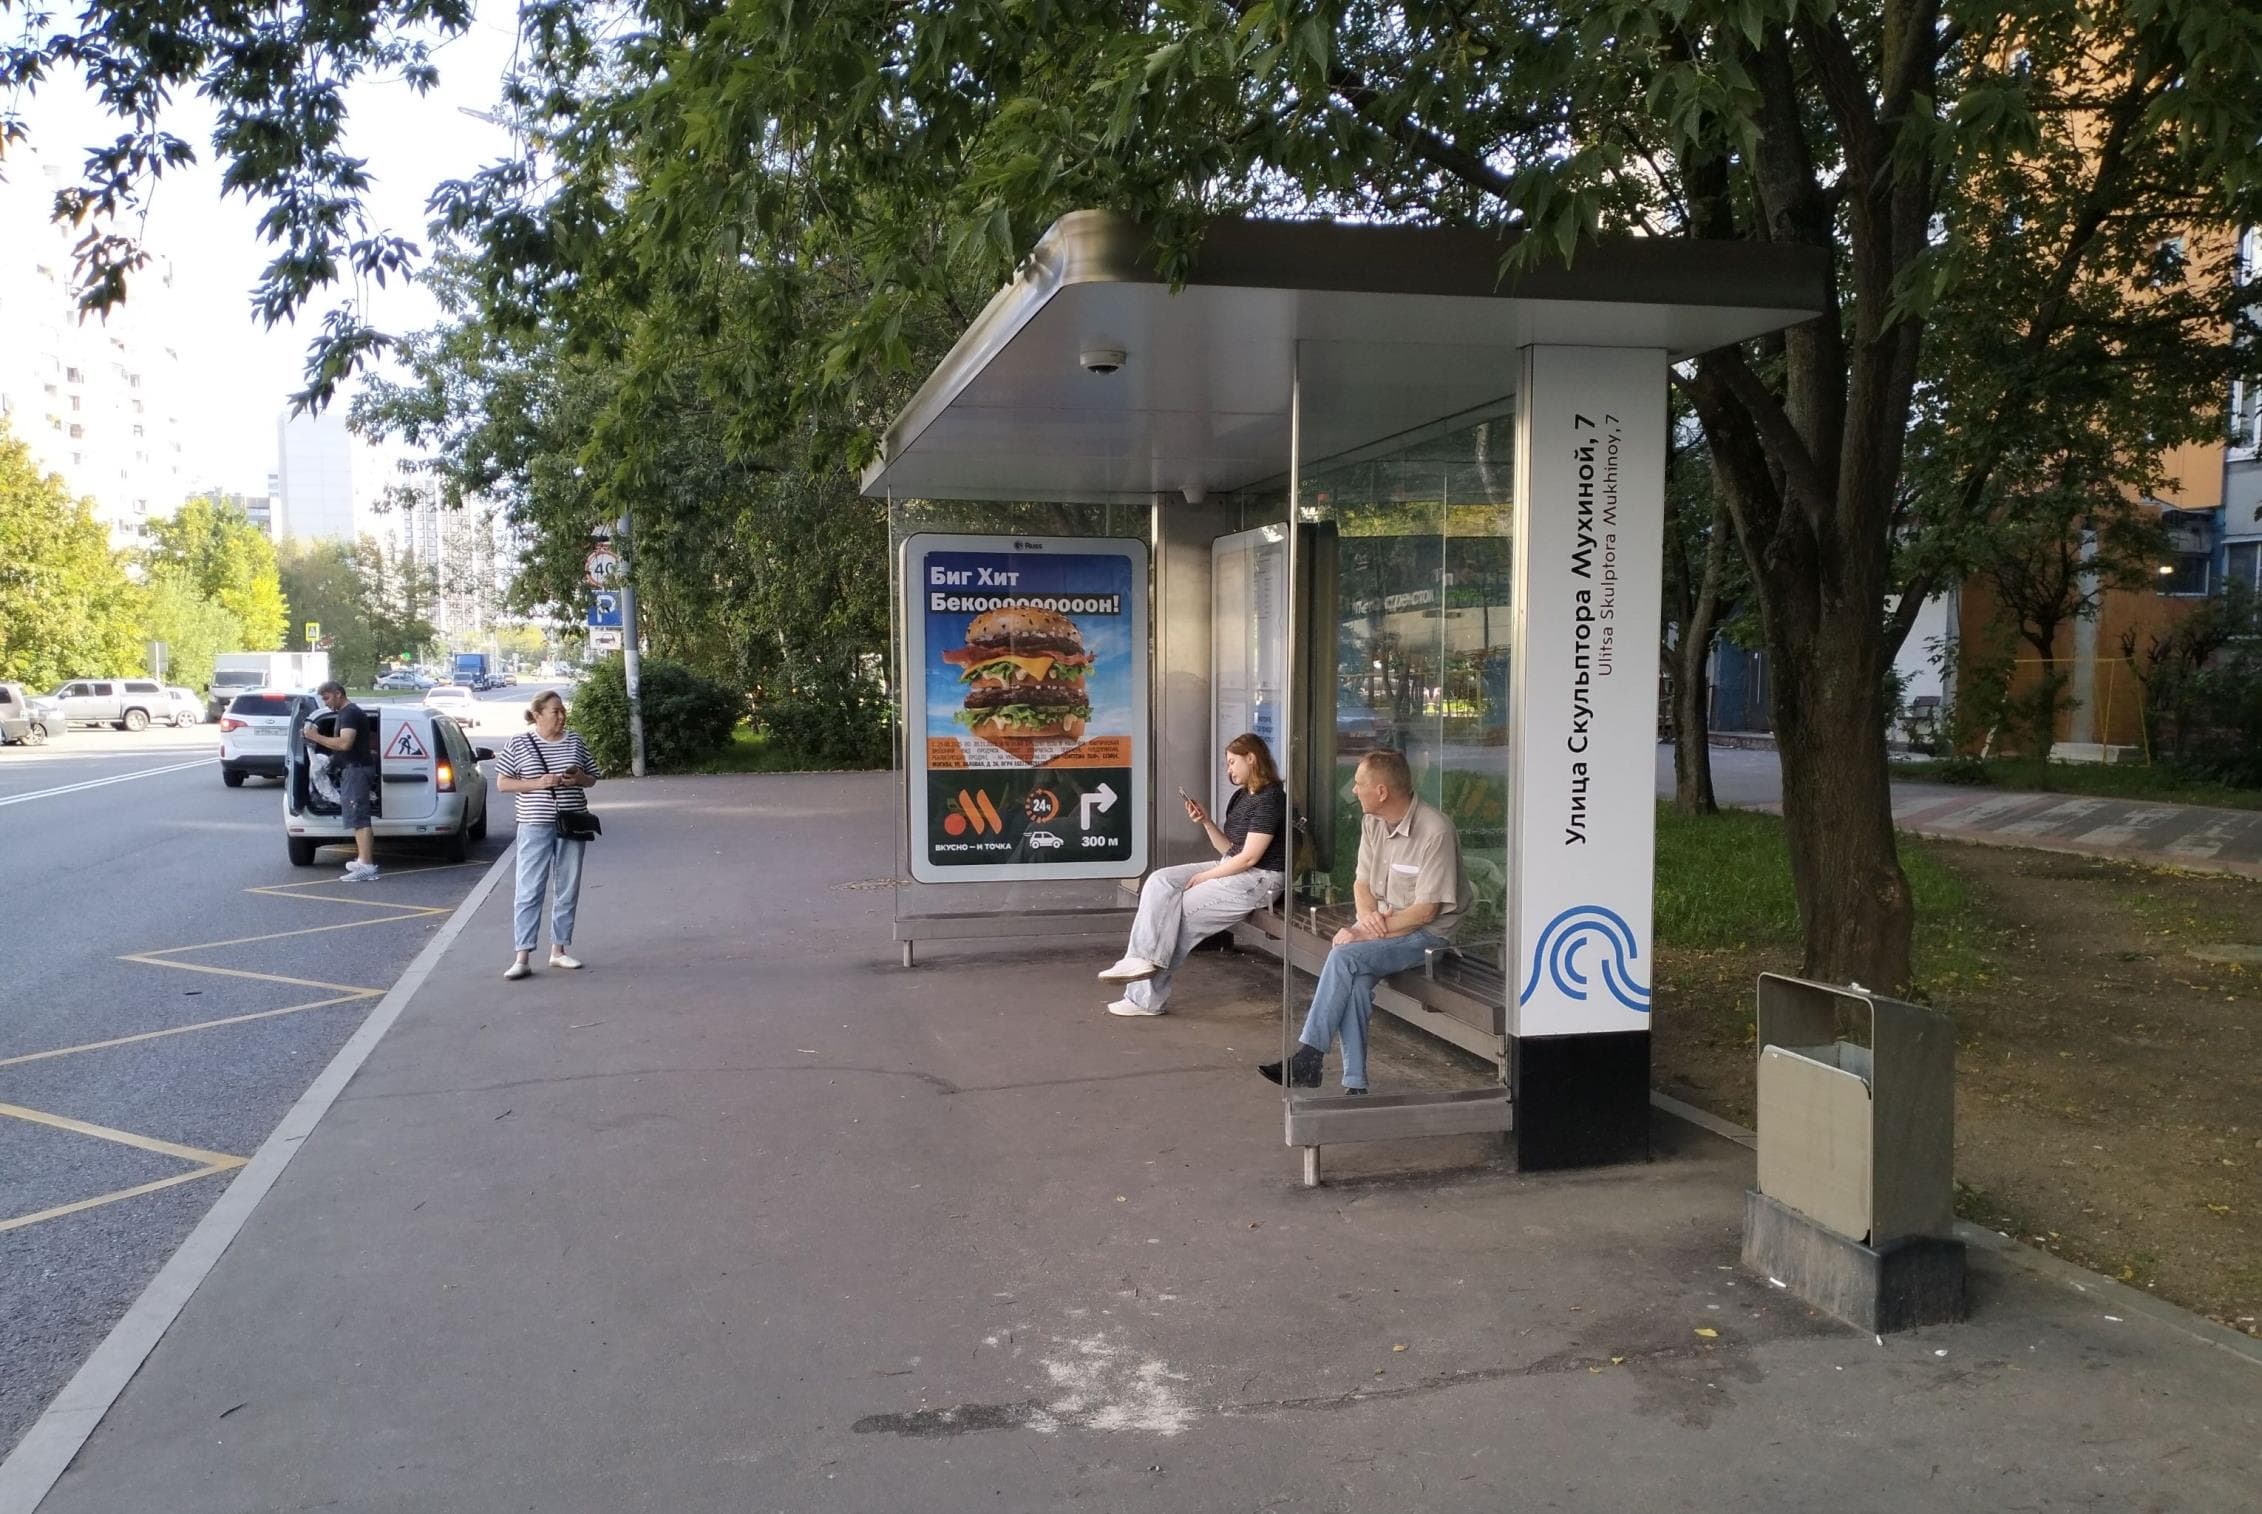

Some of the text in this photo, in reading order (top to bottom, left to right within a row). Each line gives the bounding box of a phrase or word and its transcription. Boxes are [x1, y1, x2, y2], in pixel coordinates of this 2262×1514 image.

[1598, 413, 1622, 676] Ulitsa Skulptora Mukhinoy, 7
[930, 566, 1020, 587] Биг Хит
[1565, 413, 1599, 846] Улица Скульптора Мухиной, 7
[935, 844, 968, 852] ВКУСНО
[1081, 836, 1106, 847] 300
